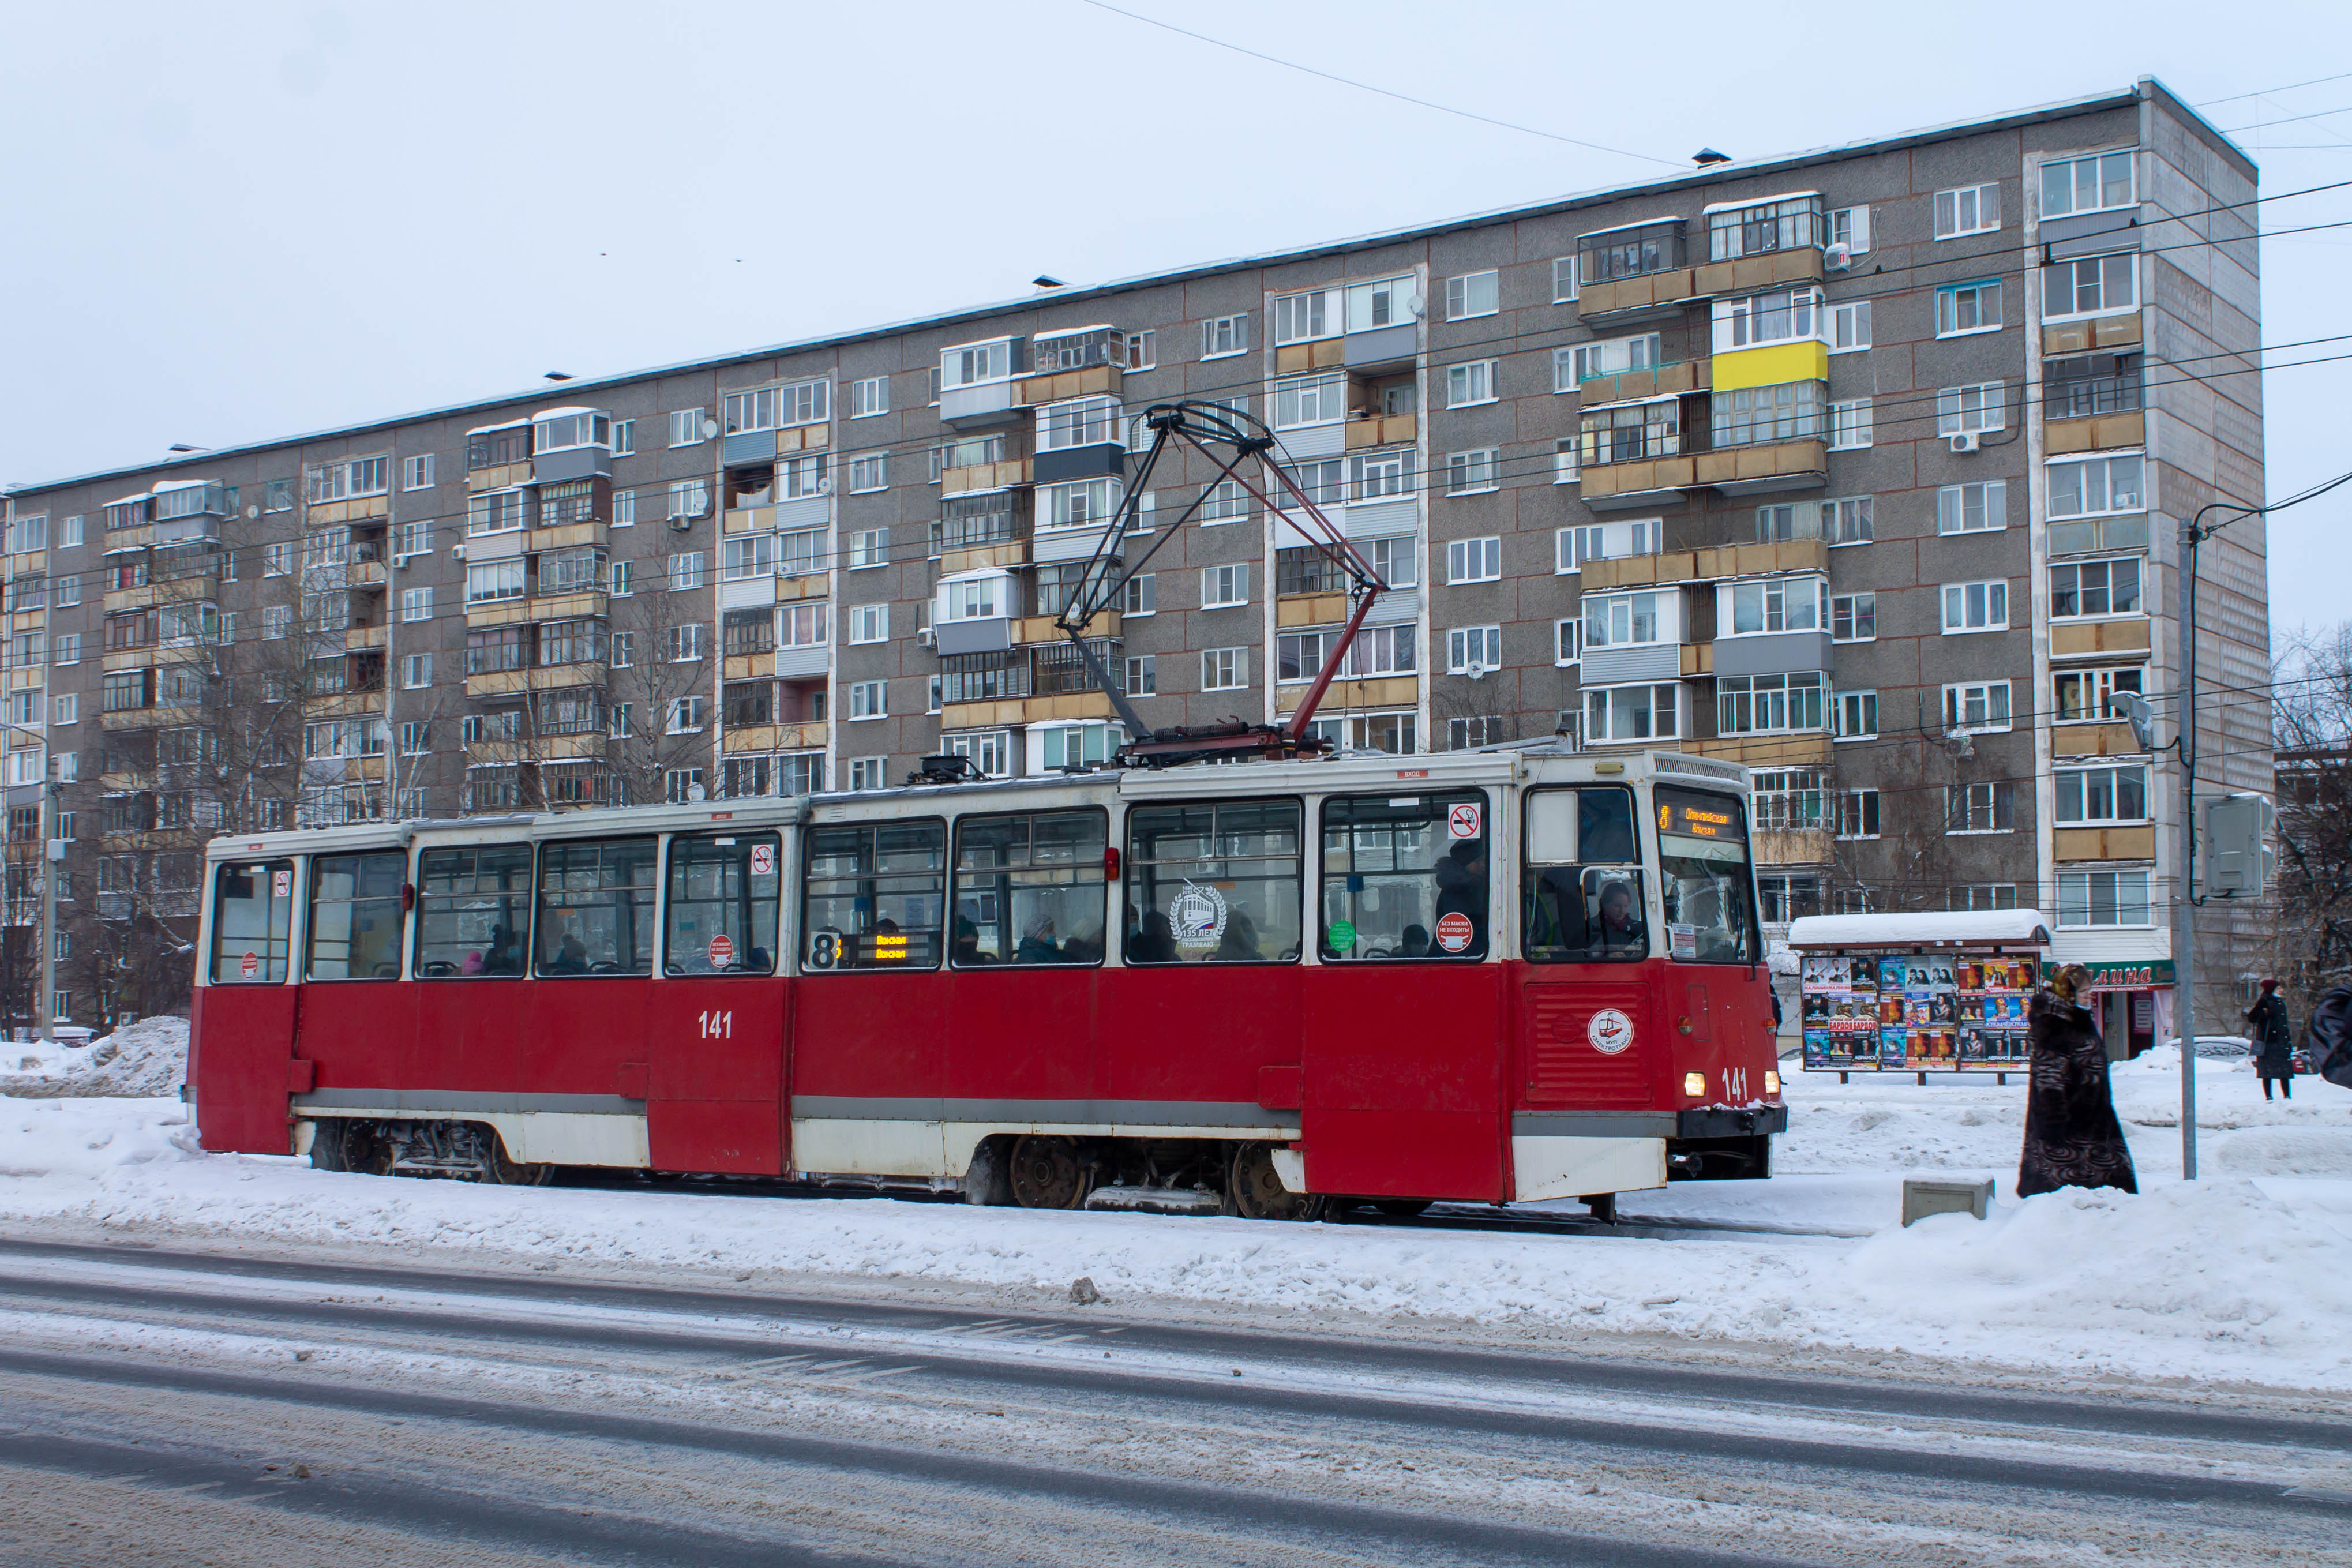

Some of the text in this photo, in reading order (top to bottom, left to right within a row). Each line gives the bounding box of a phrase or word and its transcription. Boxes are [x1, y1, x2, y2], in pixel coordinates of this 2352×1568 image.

[1659, 805, 1669, 830] 8
[812, 934, 835, 969] 8
[699, 1011, 732, 1039] 141
[1721, 1067, 1747, 1101] 141
